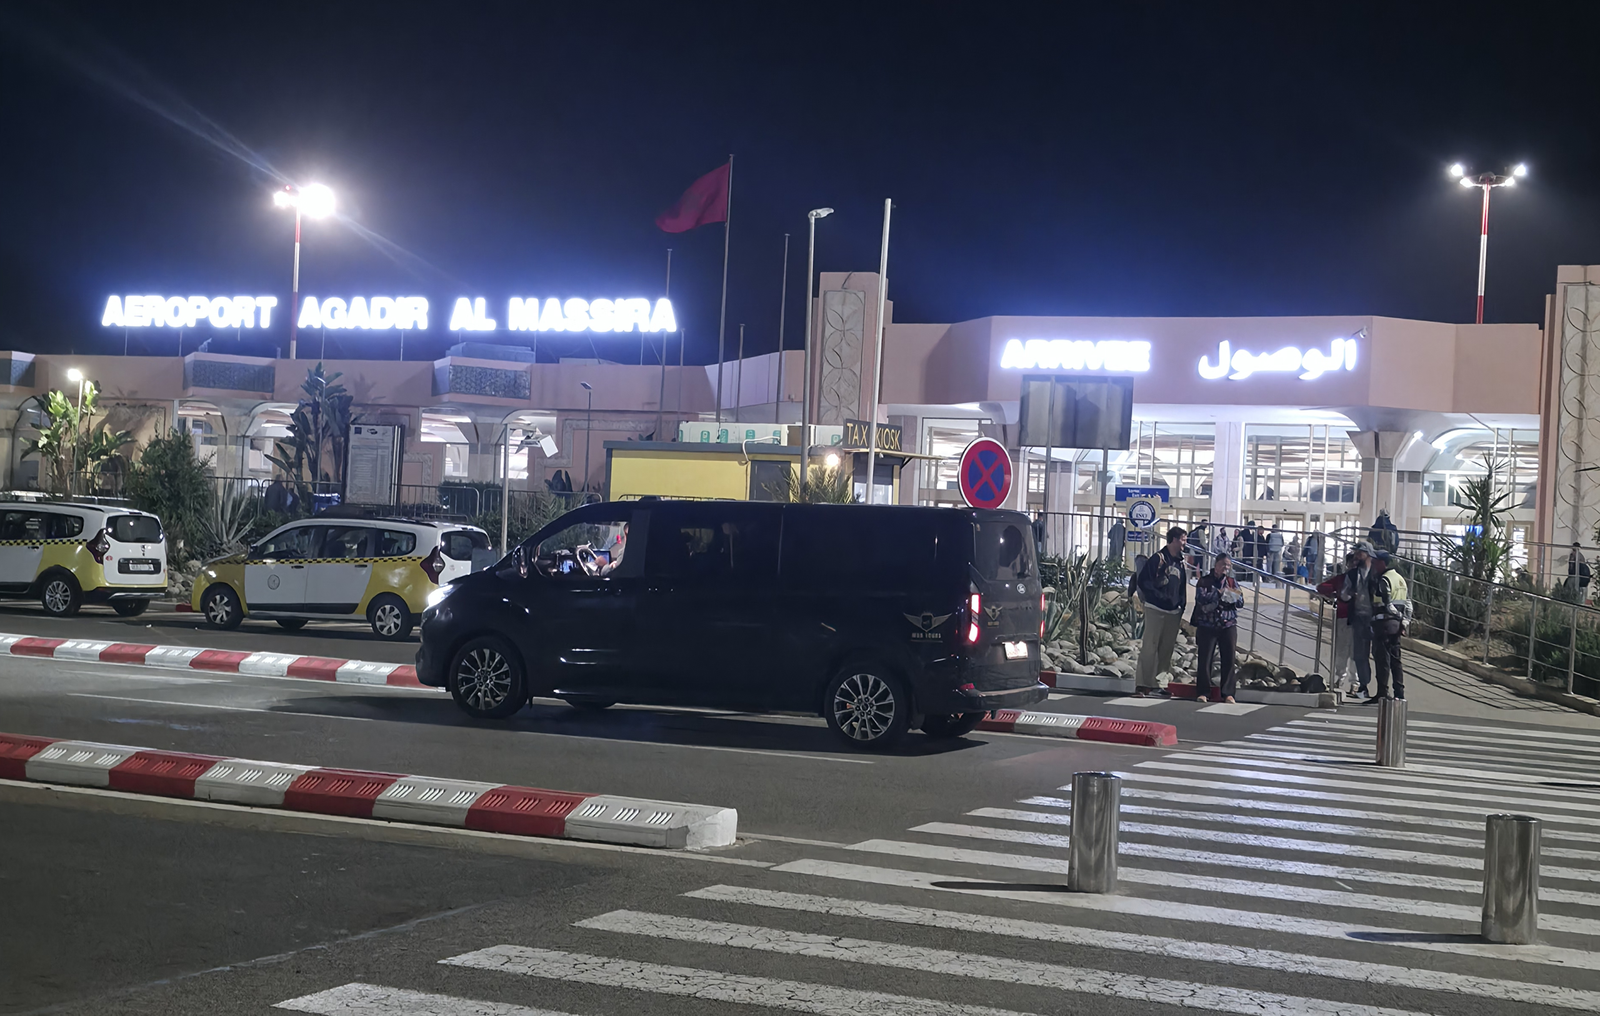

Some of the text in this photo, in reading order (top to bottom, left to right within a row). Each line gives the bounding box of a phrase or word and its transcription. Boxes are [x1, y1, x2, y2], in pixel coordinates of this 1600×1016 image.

[101, 295, 677, 333] AEROPORT AGADIR AL MASSIRA
[1198, 338, 1357, 380] الوصول
[846, 422, 871, 447] TAX
[875, 426, 901, 450] KIOSK
